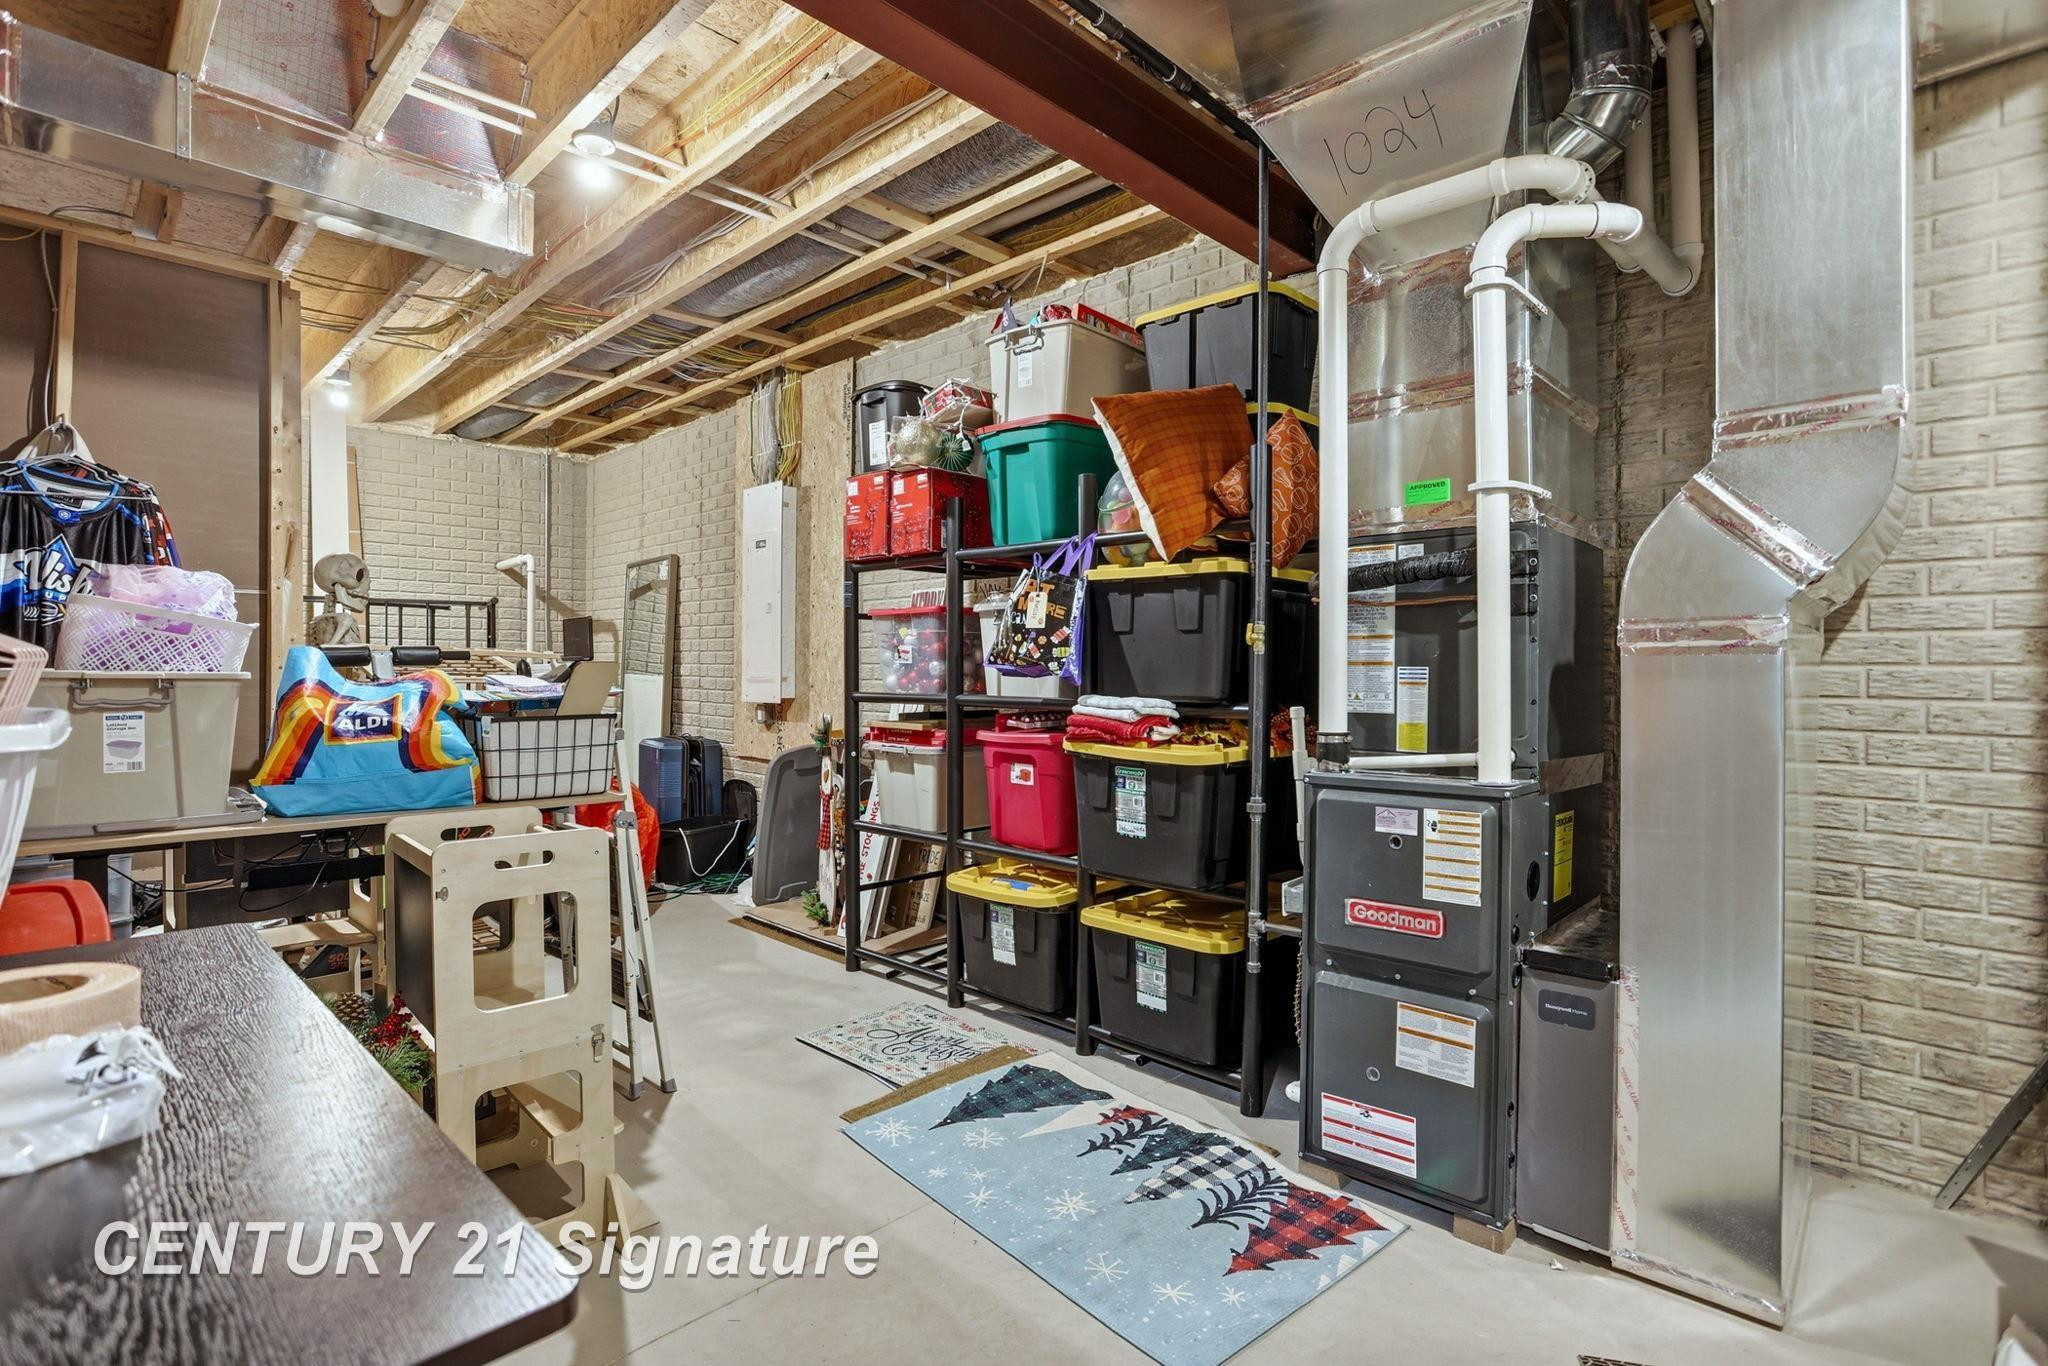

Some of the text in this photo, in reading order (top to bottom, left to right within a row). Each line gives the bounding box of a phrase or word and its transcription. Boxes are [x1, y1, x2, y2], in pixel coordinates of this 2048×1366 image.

[1323, 88, 1444, 196] 1024
[1409, 480, 1446, 491] APPROVED
[337, 716, 389, 731] ALDI
[861, 800, 881, 858] STOCINGS
[1353, 904, 1437, 932] Goodman
